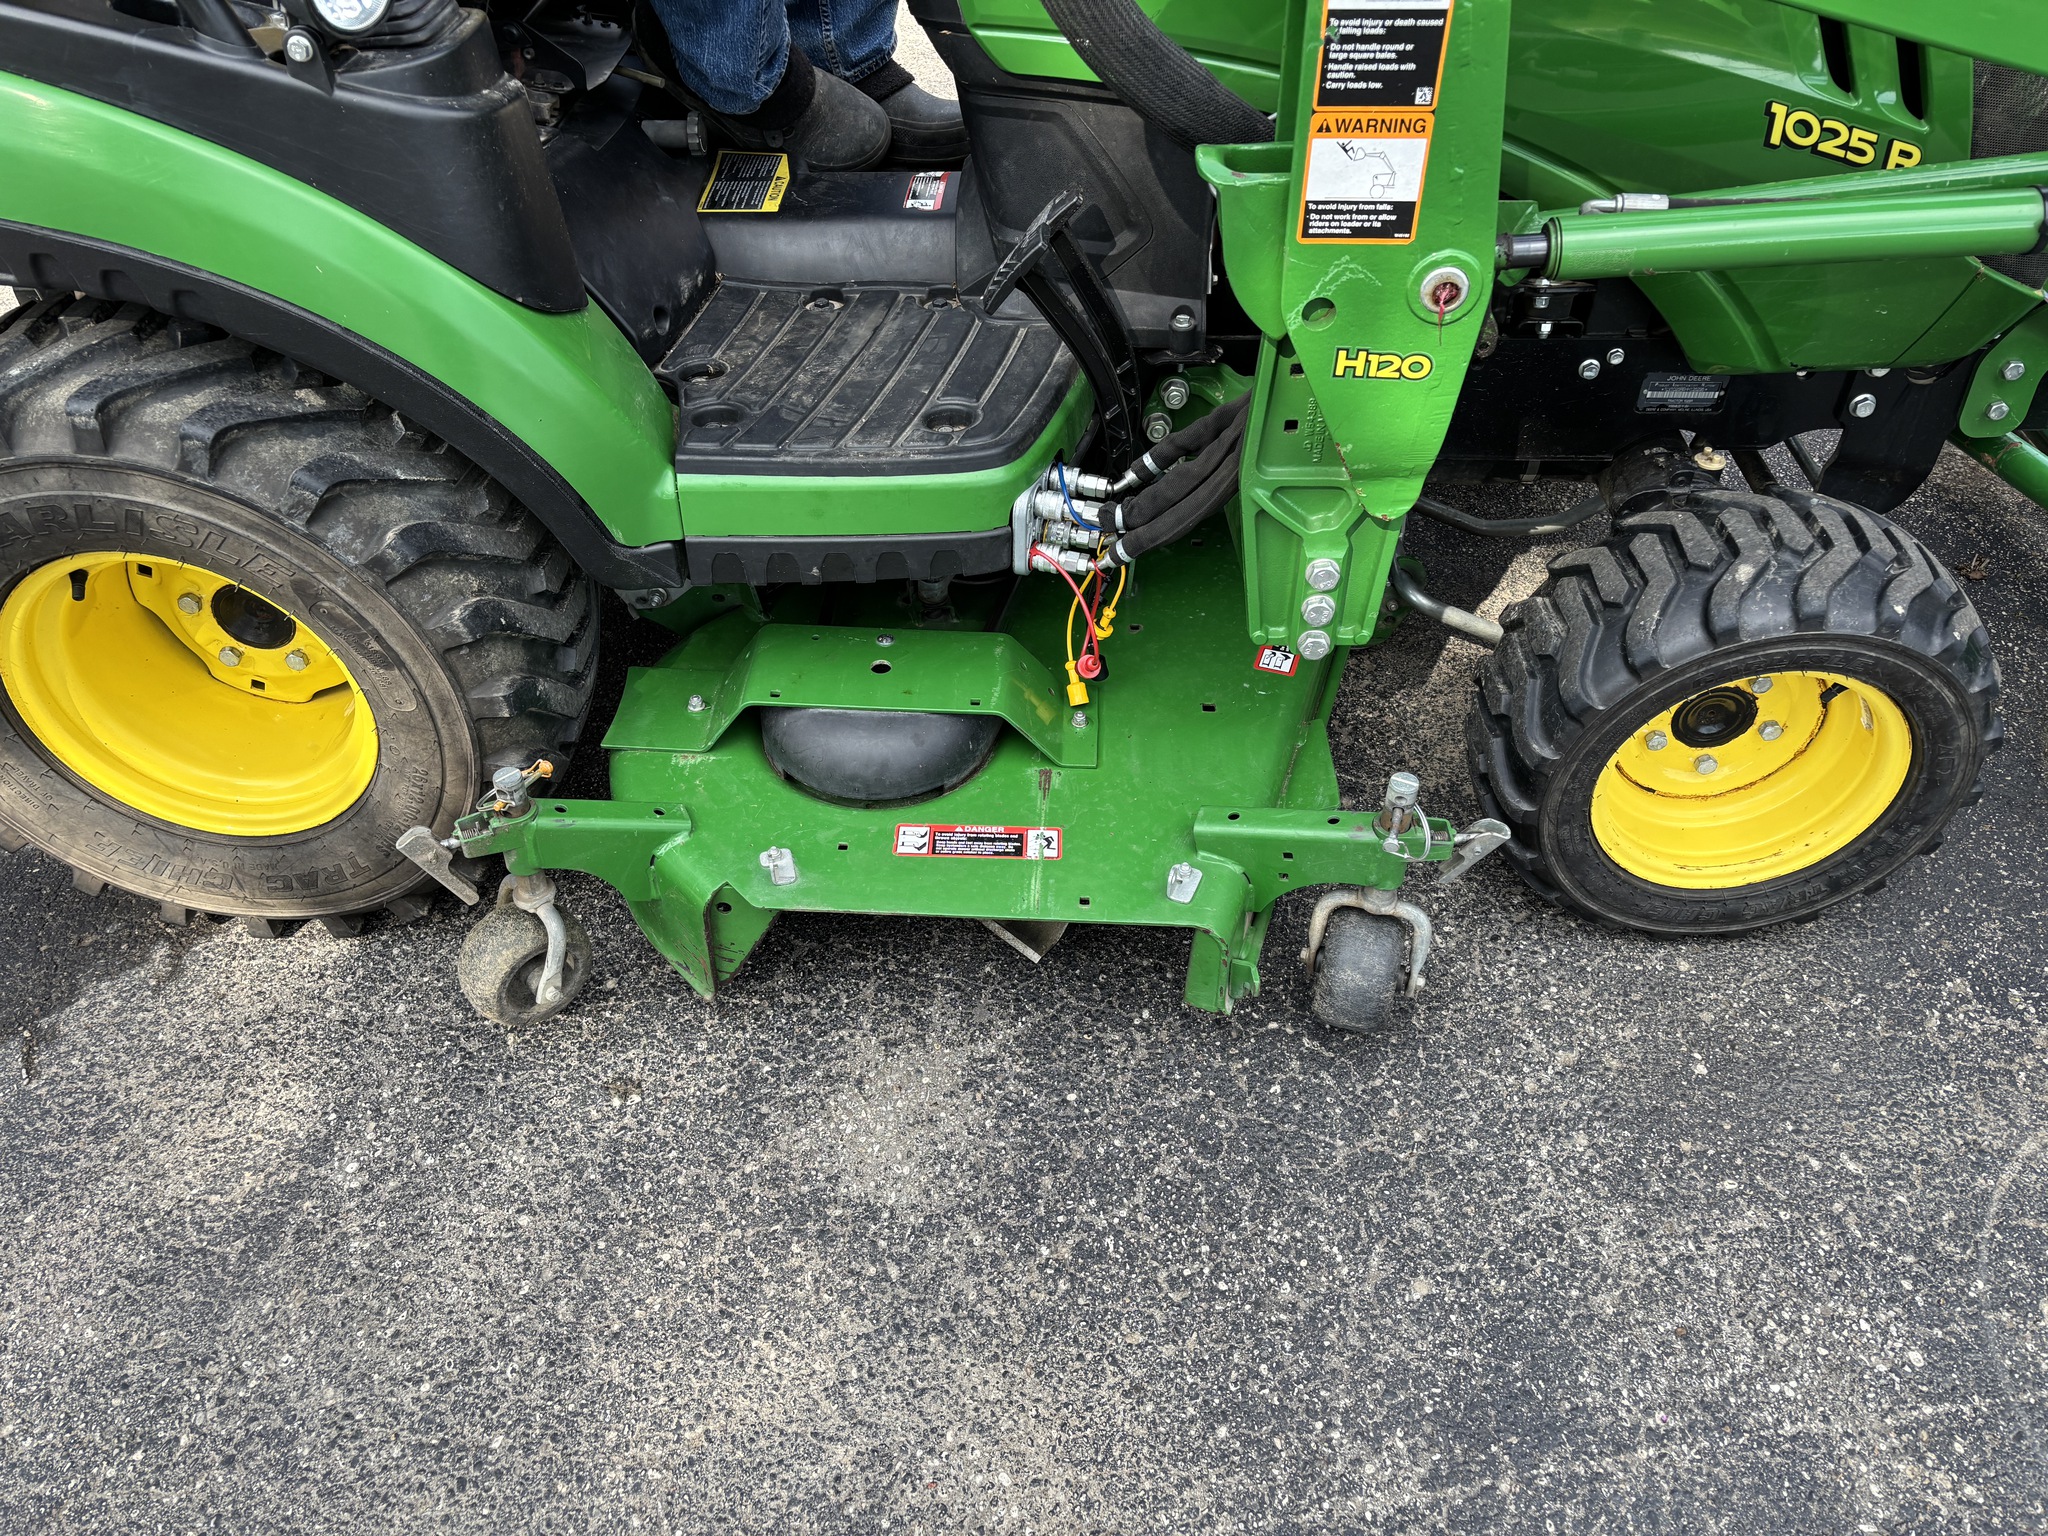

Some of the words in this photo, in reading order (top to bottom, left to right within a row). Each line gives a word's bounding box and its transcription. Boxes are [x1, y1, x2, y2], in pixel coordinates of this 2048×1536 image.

[1330, 18, 1339, 26] To
[1340, 18, 1361, 26] avoid
[1362, 18, 1383, 28] injury
[1394, 18, 1416, 26] death
[1417, 18, 1444, 26] caused
[1339, 27, 1362, 36] falling
[1363, 27, 1387, 35] loads:
[1330, 43, 1341, 51] Do
[1356, 43, 1380, 51] handle
[1382, 43, 1404, 51] round
[1329, 52, 1348, 60] large
[1349, 52, 1374, 60] square
[1375, 51, 1398, 59] bales.
[1327, 63, 1353, 71] Handle
[1354, 63, 1377, 71] raised
[1400, 63, 1416, 71] with
[1326, 71, 1356, 79] caution.
[1325, 81, 1346, 91] Carry
[1347, 81, 1367, 89] loads
[1368, 81, 1383, 89] low.
[1335, 118, 1427, 133] WARNING
[1764, 99, 1879, 167] 1025
[767, 180, 785, 202] CAUTION
[1338, 203, 1357, 212] injury
[1358, 203, 1376, 211] from
[1376, 203, 1394, 211] falls:
[1378, 213, 1397, 221] allow
[1333, 348, 1433, 380] H120
[1316, 423, 1327, 434] IN
[1312, 434, 1326, 464] MADE
[14, 767, 41, 791] TRAVEL
[40, 792, 53, 801] OF
[86, 837, 234, 891] CHIEF
[248, 861, 280, 870] MADE
[266, 855, 371, 894] TRAC
